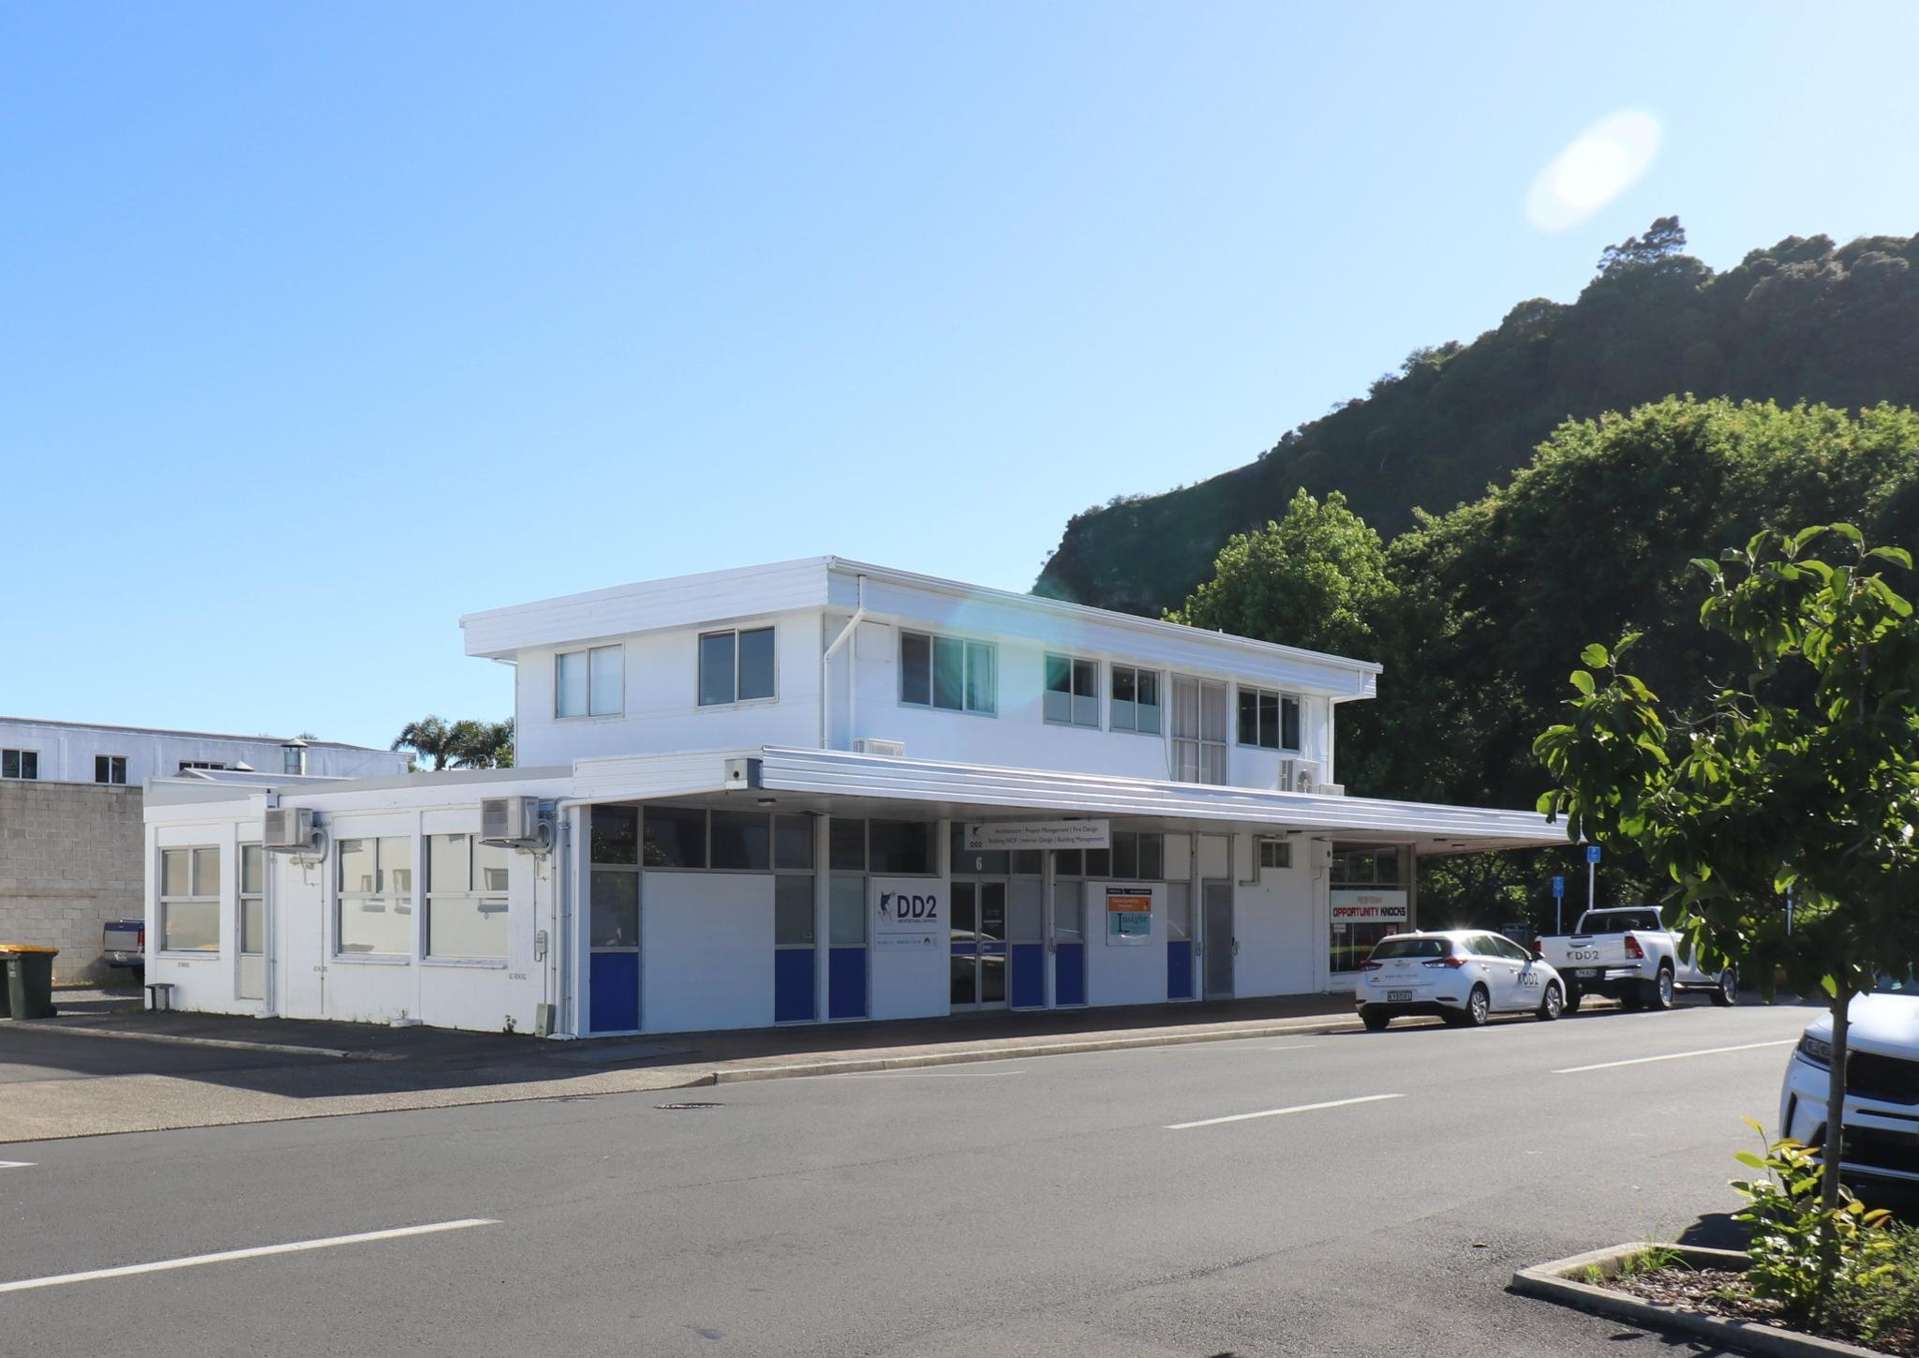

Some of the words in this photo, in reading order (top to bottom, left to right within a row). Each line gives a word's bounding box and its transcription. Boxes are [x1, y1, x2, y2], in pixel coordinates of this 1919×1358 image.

[976, 856, 983, 871] 6
[897, 895, 937, 919] DD2
[1333, 907, 1379, 917] OPPORTUNITY
[1380, 907, 1406, 917] KNOCKS
[1575, 951, 1600, 961] DD2
[1523, 971, 1539, 986] DD2
